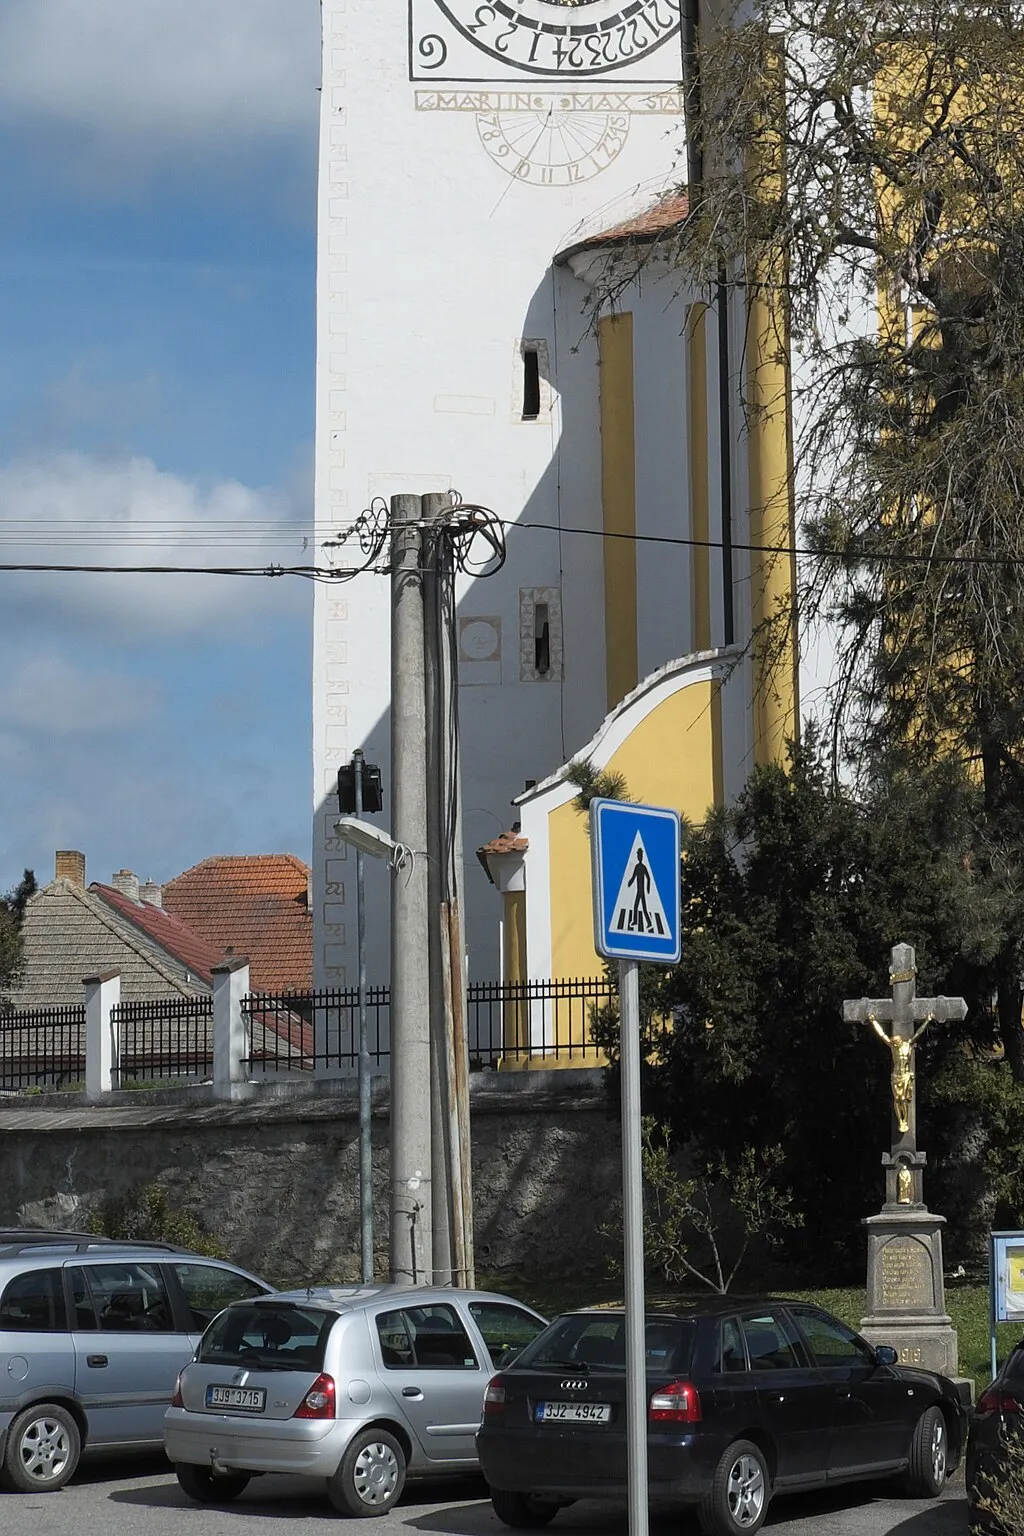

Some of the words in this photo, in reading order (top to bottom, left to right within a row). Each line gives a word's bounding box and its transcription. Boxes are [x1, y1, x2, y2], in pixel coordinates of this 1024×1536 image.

[466, 5, 496, 35] 3
[638, 0, 673, 39] 21
[494, 21, 519, 52] 2
[528, 31, 544, 63] 1
[584, 32, 618, 66] 23
[616, 19, 648, 57] 22
[552, 37, 583, 70] 24
[573, 95, 632, 111] MAX
[214, 1389, 230, 1403] 3J9
[236, 1391, 260, 1405] 3715
[546, 1404, 567, 1418] 3J2
[575, 1405, 604, 1419] 4942
